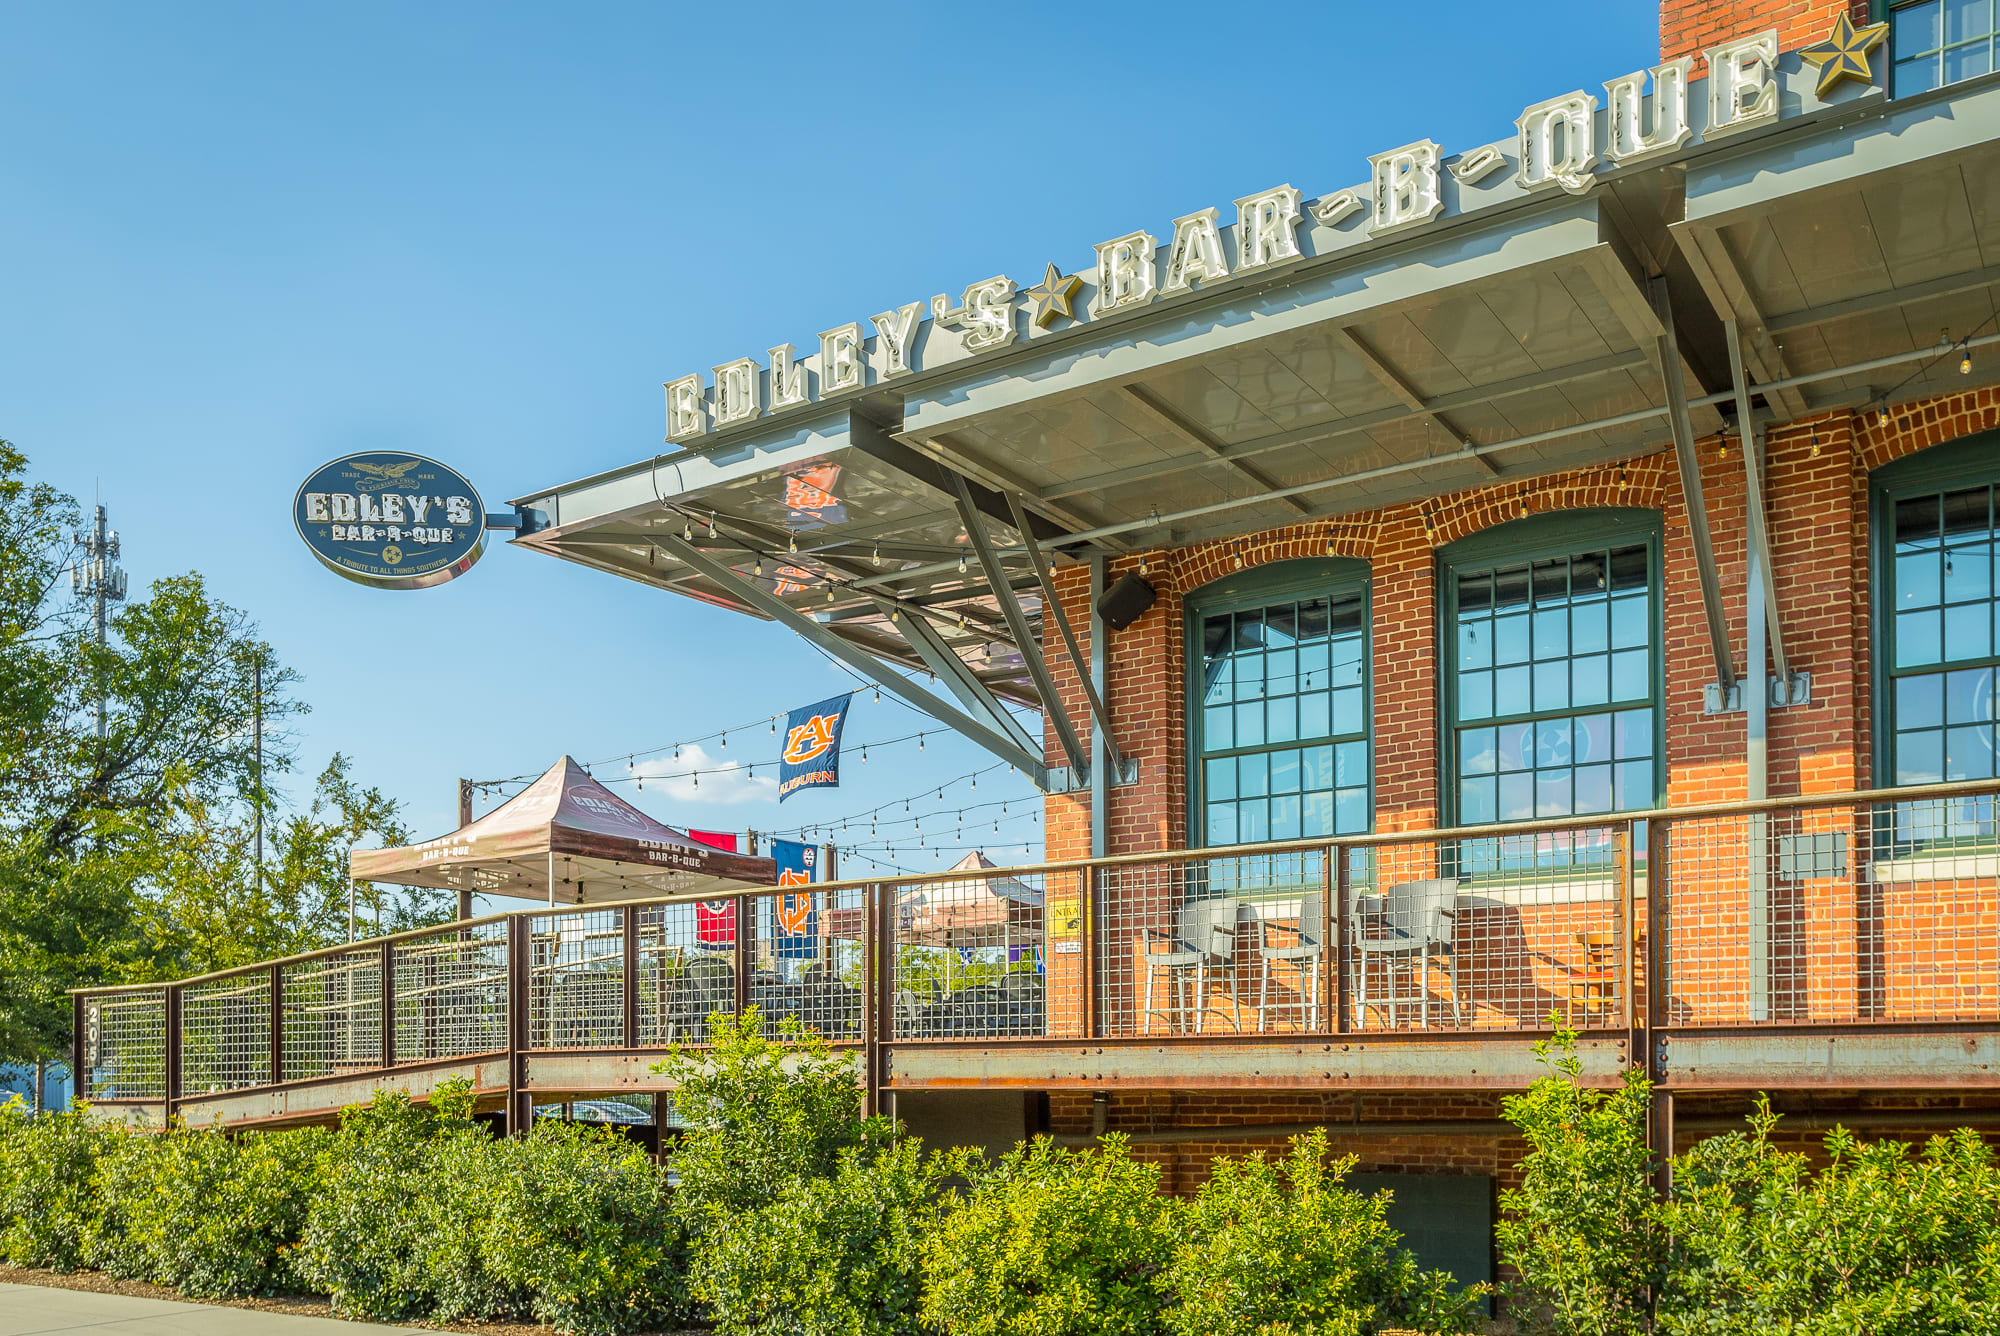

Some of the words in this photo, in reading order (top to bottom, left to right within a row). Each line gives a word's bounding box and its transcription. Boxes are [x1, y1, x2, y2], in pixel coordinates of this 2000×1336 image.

[663, 274, 1019, 442] EDLEY'S
[1092, 28, 1779, 318] BAR-B-QUE
[305, 493, 475, 526] EDLEY'S
[331, 525, 454, 545] BAR-B-QUE
[343, 558, 368, 571] TRIBUTE
[416, 558, 448, 572] SOUTHERN
[779, 770, 835, 797] AUBURN
[422, 845, 470, 861] BAR-B-QUE
[648, 851, 701, 868] BAR-B-QUE
[89, 1007, 98, 1062] 205
